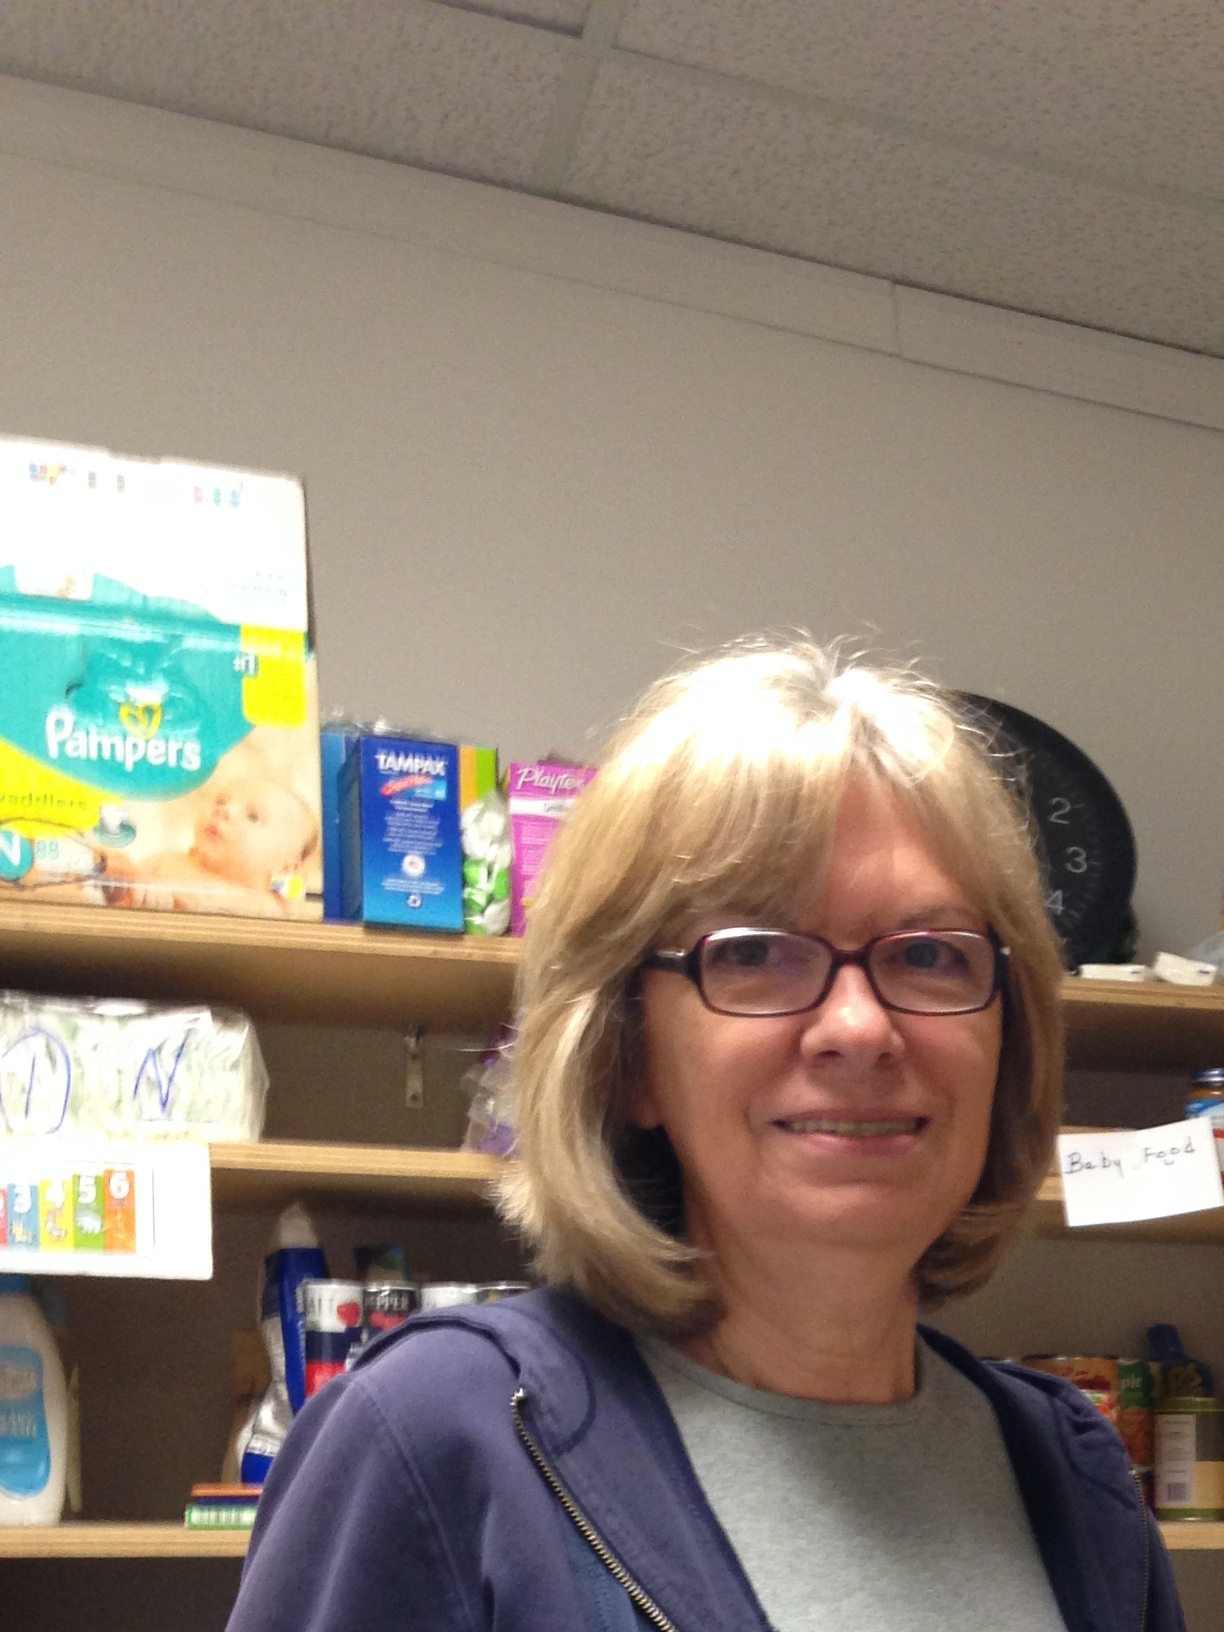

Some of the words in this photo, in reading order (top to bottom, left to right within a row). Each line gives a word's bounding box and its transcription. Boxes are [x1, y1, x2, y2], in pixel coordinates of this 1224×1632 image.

[45, 704, 201, 771] Pampers
[376, 752, 447, 776] TAMPAX
[1049, 797, 1071, 825] 2
[1065, 846, 1088, 874] 3
[1044, 889, 1065, 917] 4
[1064, 1151, 1125, 1178] Baby
[1144, 1136, 1196, 1164] Food
[109, 1170, 130, 1200] 6
